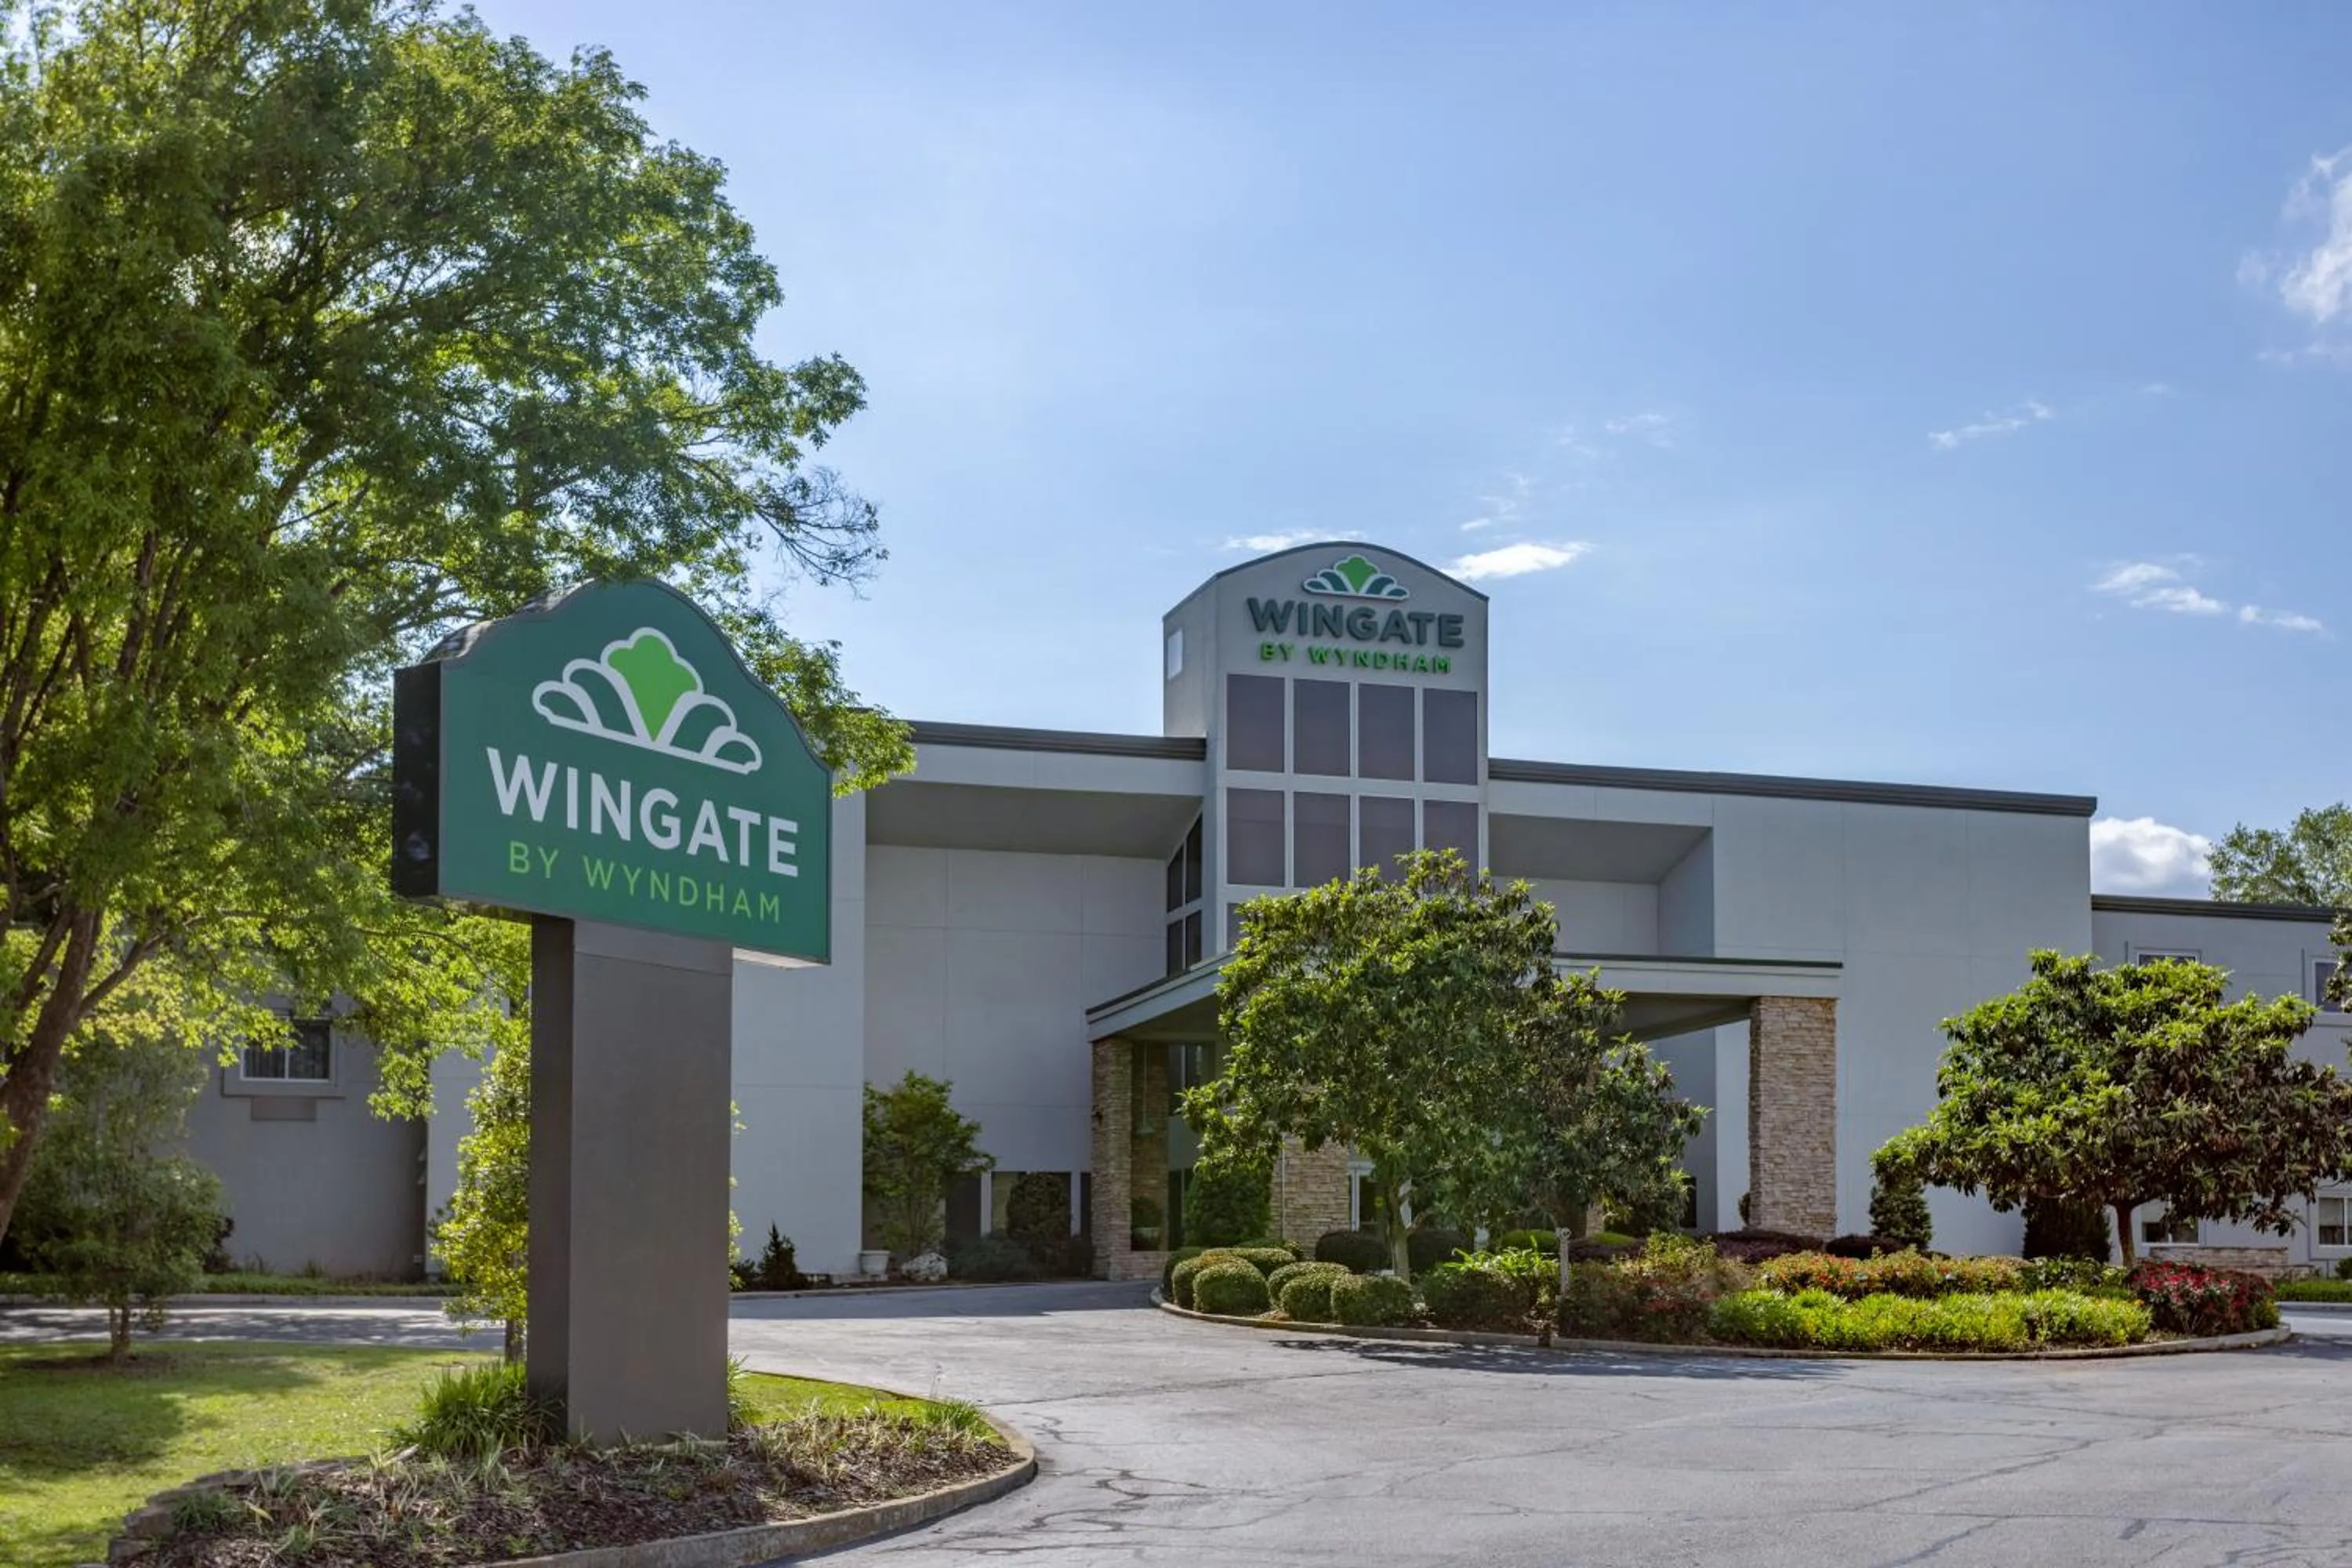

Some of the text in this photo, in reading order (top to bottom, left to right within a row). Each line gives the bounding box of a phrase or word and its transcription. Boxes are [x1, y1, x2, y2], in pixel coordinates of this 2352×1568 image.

[1247, 597, 1465, 648] WINGATE
[1260, 642, 1451, 673] BY WYNDHAM
[486, 747, 798, 877] WINGATE
[509, 841, 781, 924] BY WYNDHAM
